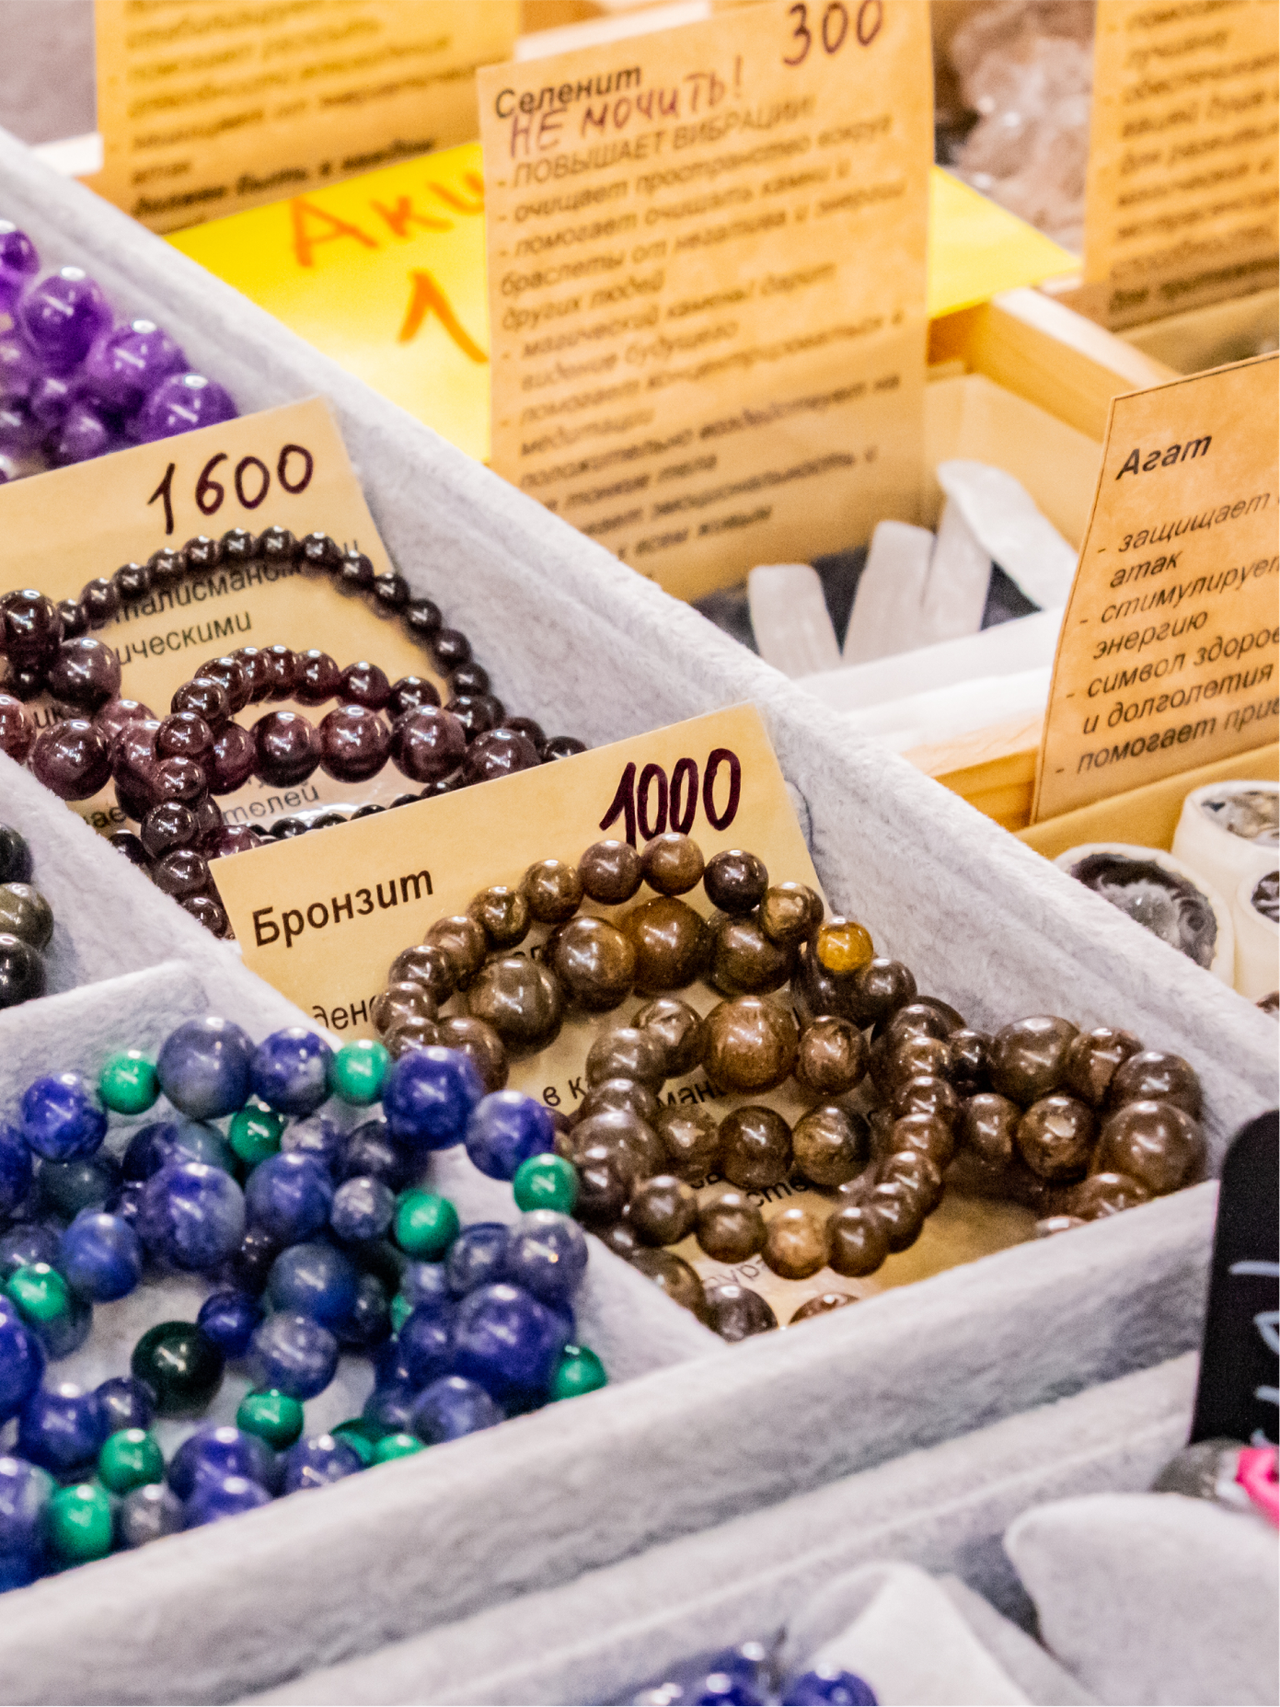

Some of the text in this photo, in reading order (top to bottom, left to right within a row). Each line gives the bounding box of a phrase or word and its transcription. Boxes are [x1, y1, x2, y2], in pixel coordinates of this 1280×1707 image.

[782, 0, 884, 67] 300
[495, 66, 641, 119] Селенит
[510, 105, 567, 158] НЕ
[514, 131, 664, 188] ПОВЫШАЕТ
[515, 180, 628, 222] очищает
[515, 212, 638, 256] помогает
[1115, 434, 1213, 480] Агат
[146, 442, 315, 536] 1600
[1118, 491, 1271, 555] защищает
[1109, 550, 1183, 589] атак
[115, 611, 253, 666] ическими
[1092, 609, 1209, 661] энергию
[1082, 662, 1275, 736] и долголетия
[1087, 652, 1186, 701] символ
[1075, 715, 1217, 776] помогает
[599, 747, 742, 848] 1000
[252, 868, 435, 948] Бронзит
